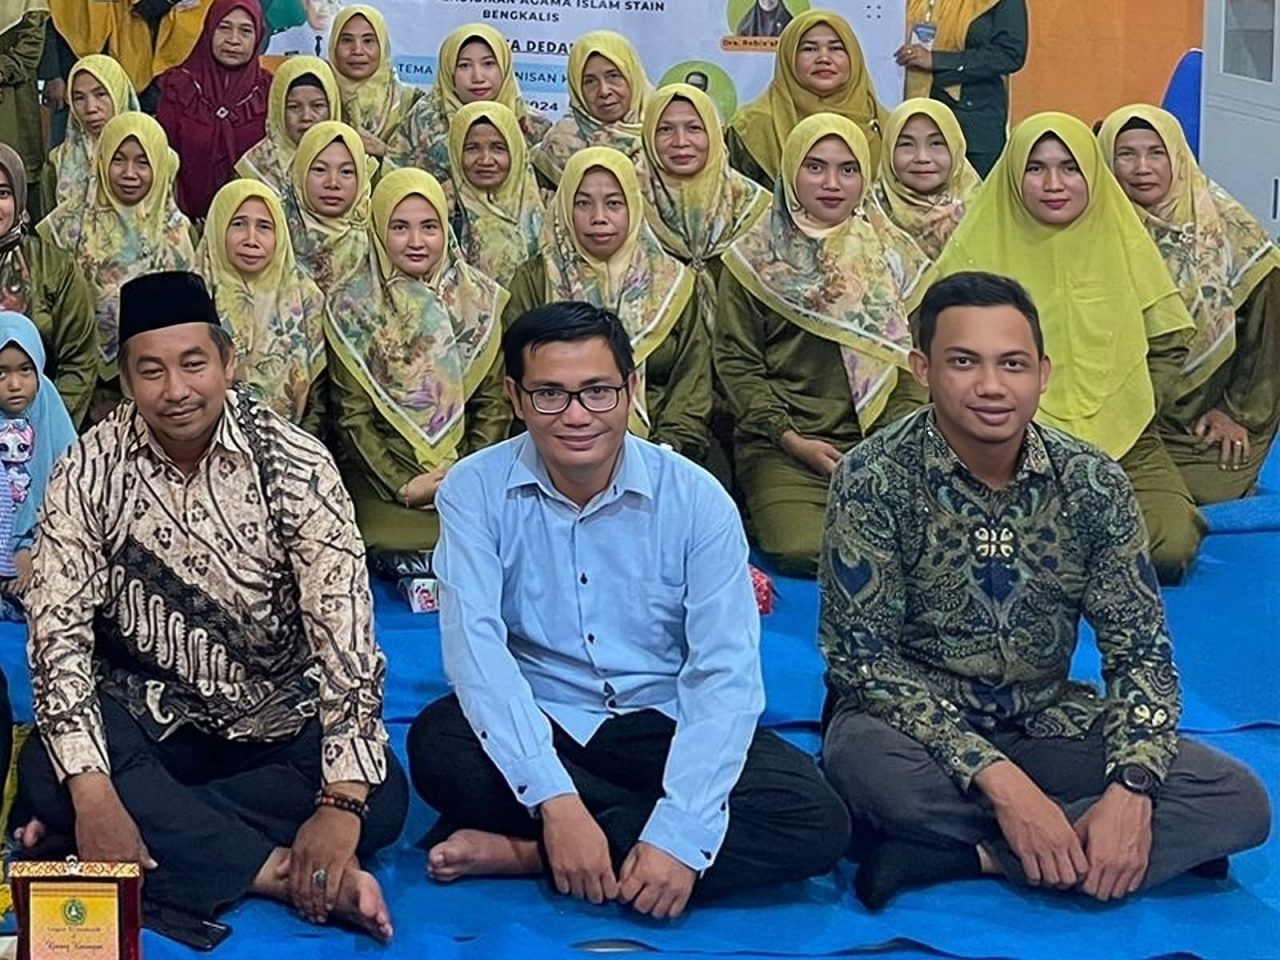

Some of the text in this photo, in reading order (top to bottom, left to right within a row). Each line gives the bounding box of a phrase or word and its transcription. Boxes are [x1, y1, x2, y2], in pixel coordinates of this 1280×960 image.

[624, 0, 665, 12] STAIN
[482, 8, 560, 23] BENGKALIS
[526, 40, 573, 55] DEDA
[397, 62, 433, 75] TEMA
[514, 71, 557, 83] NISAN
[525, 100, 558, 112] 024
